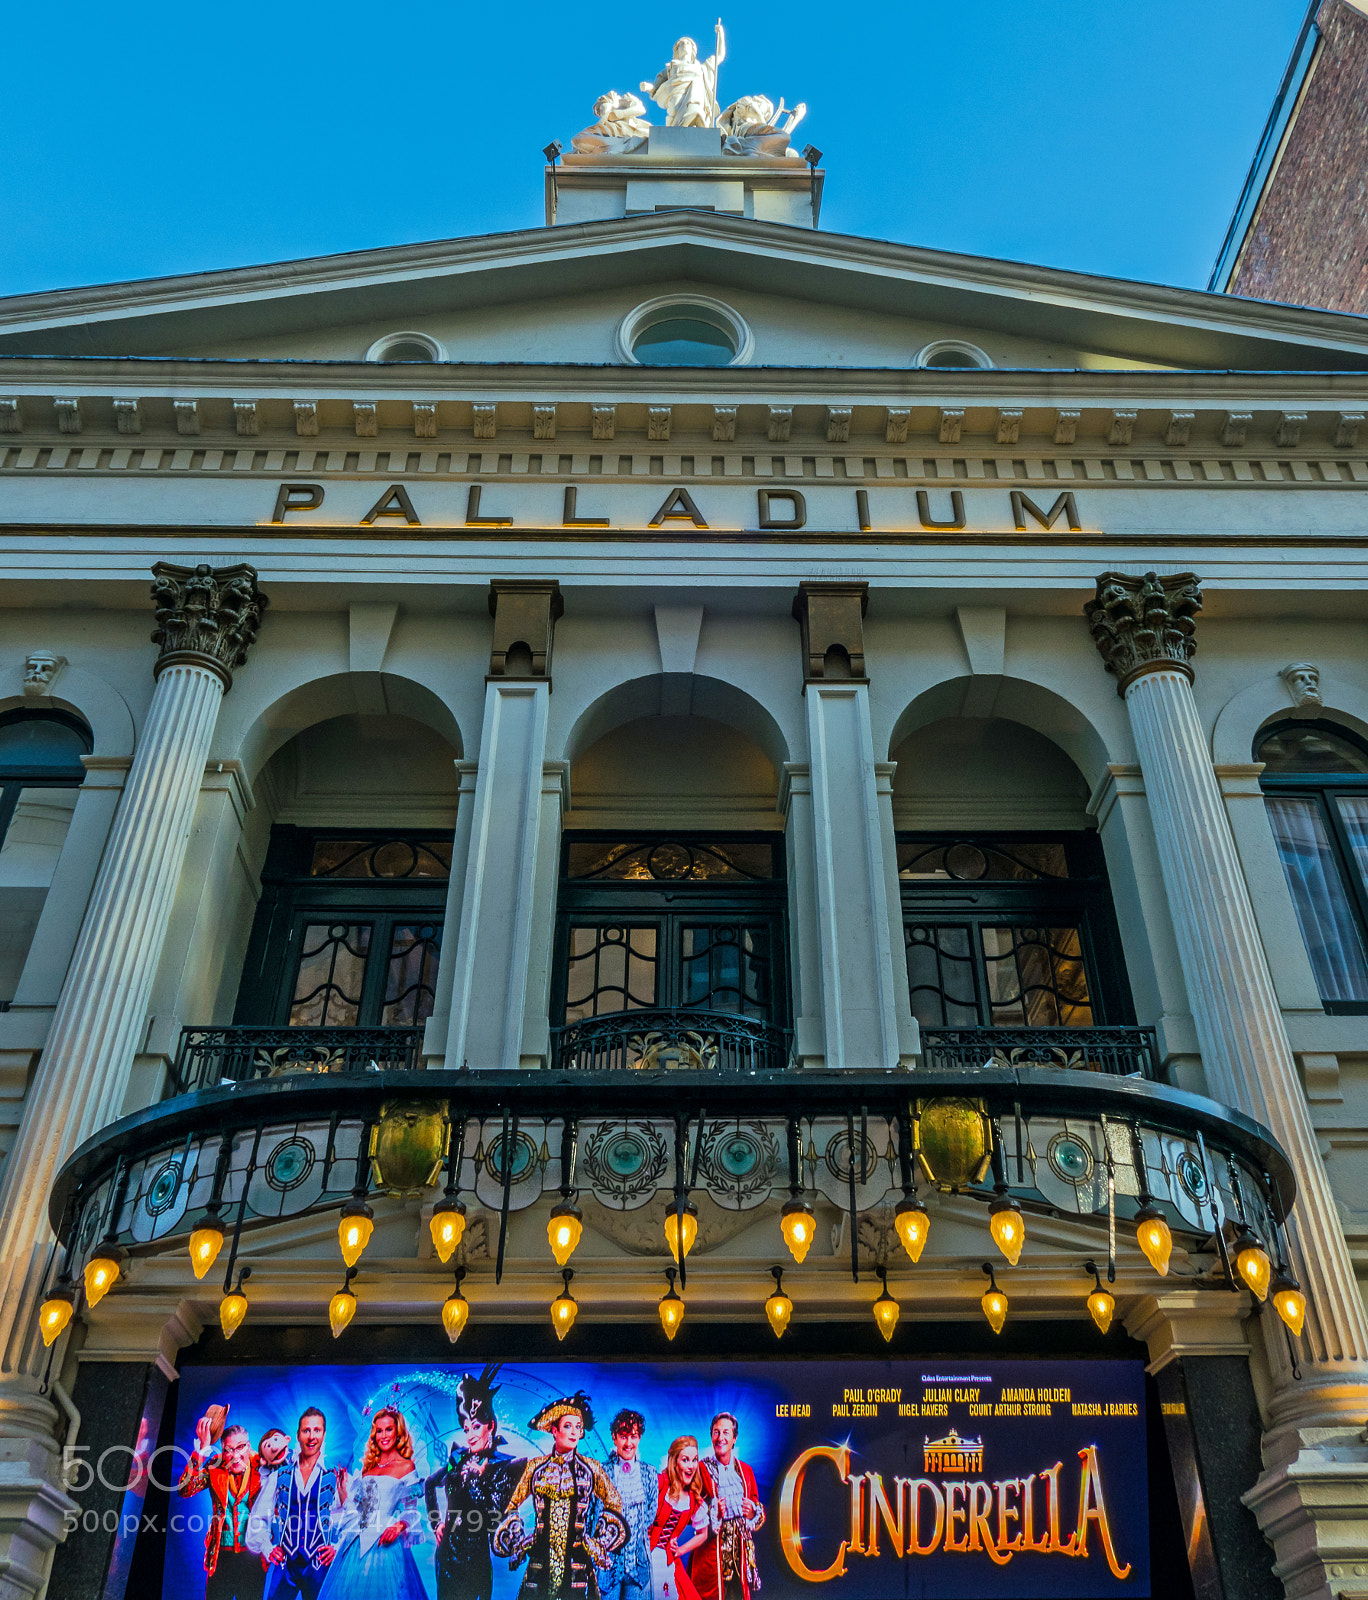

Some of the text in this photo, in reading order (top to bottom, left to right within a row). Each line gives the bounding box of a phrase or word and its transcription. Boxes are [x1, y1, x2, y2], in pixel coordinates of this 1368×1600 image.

[270, 483, 1082, 532] PALLADIUM
[775, 1403, 1139, 1417] LEE MEAD PAUL ZERDIN NIGEL HAVERS COUNT ARTHUR STRONG NATASHA J BARNES
[844, 1388, 1071, 1403] PAUL O'GRADY JULIAN CLARY AMANDA HOLDEN
[779, 1443, 1132, 1582] CINDERELLA
